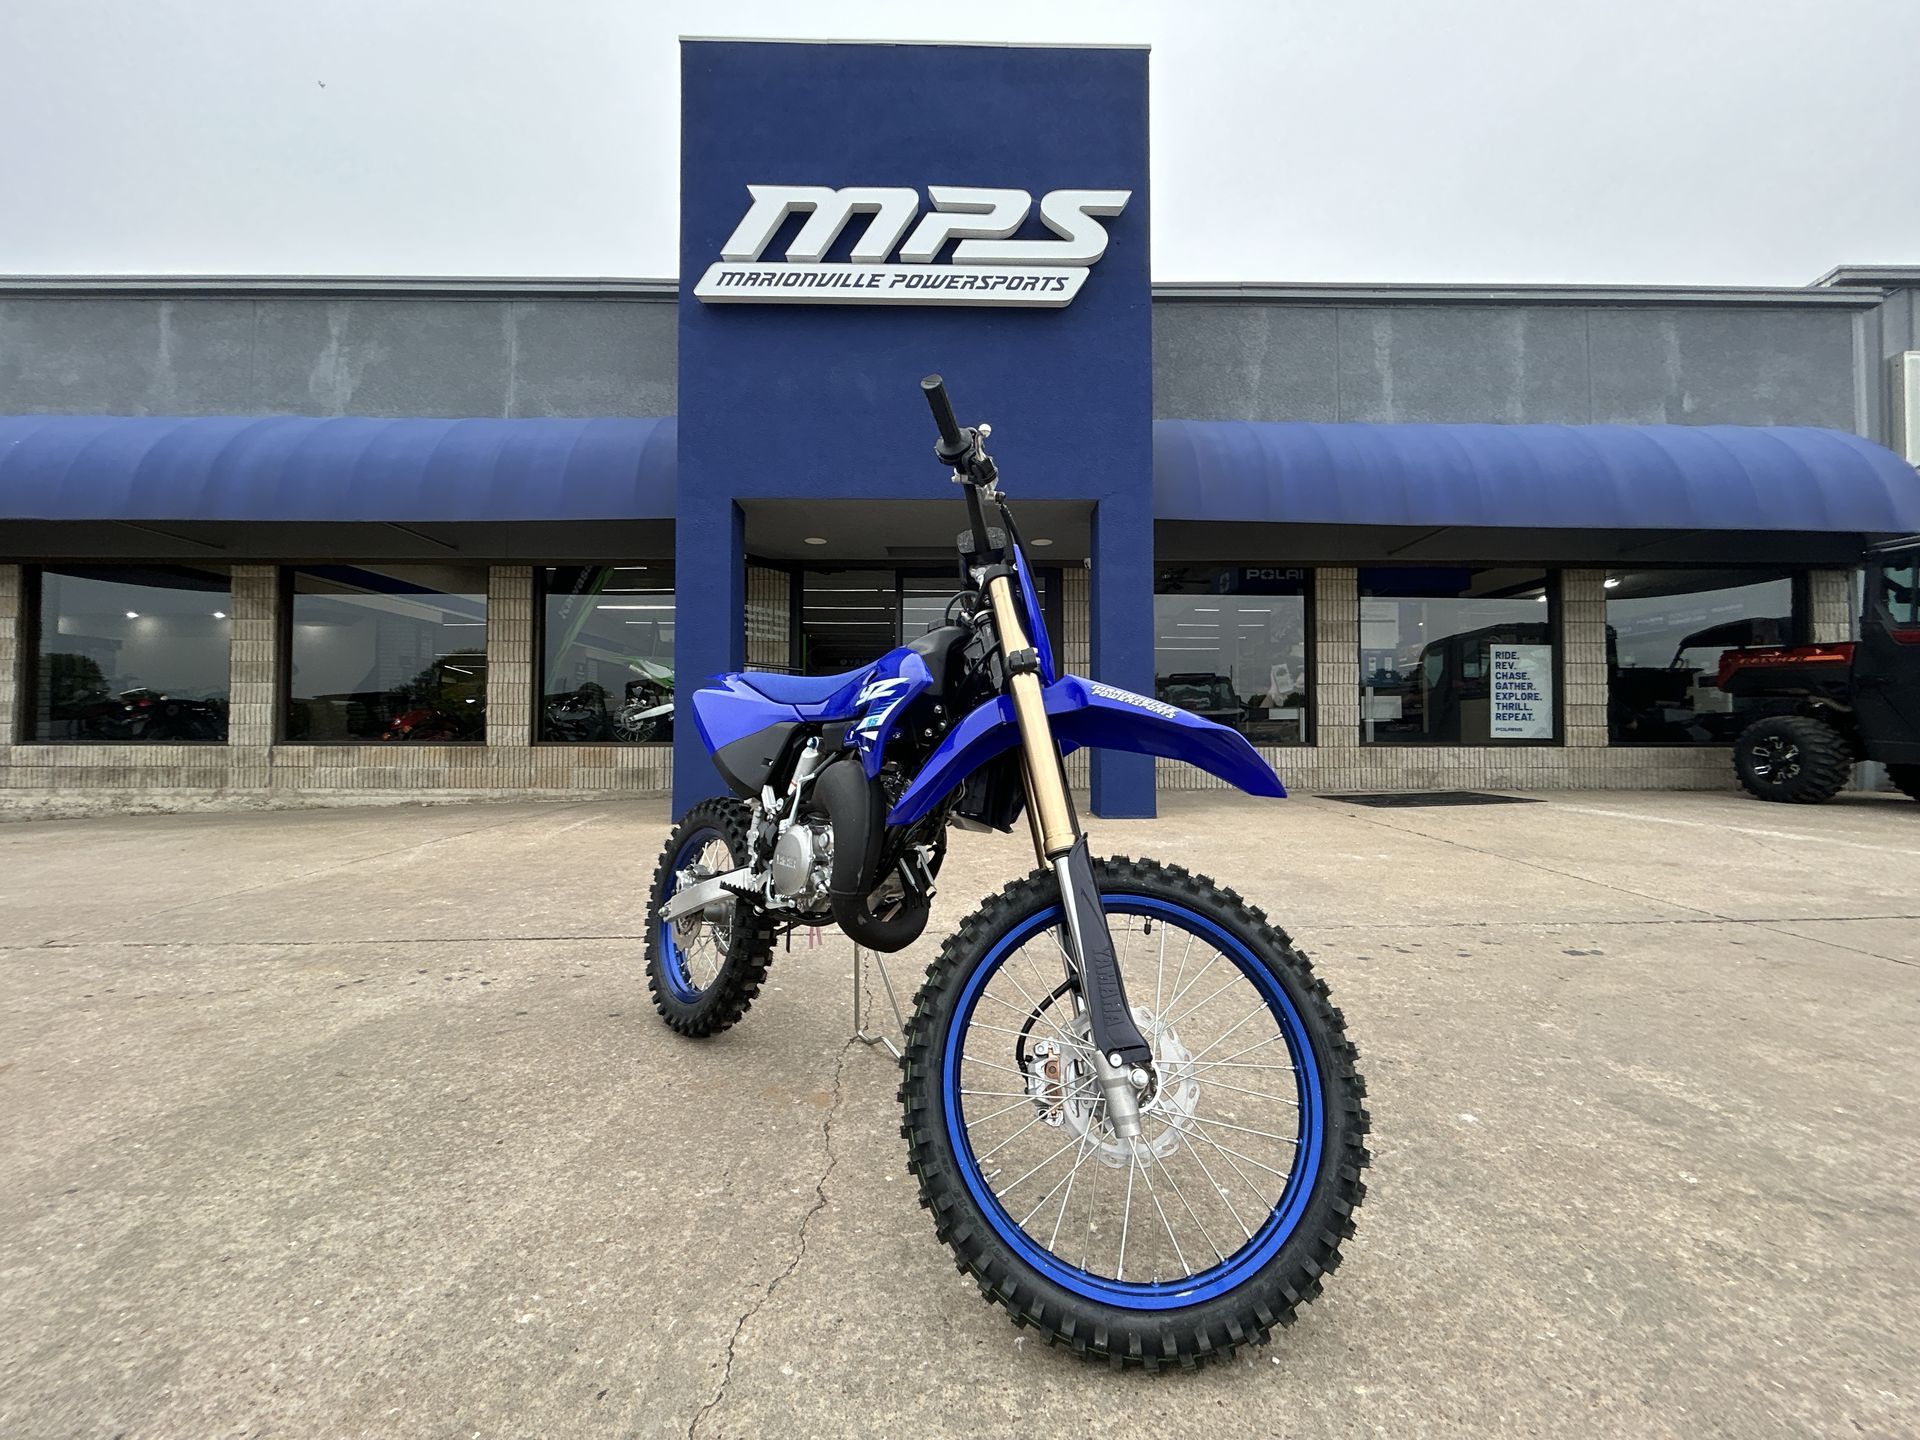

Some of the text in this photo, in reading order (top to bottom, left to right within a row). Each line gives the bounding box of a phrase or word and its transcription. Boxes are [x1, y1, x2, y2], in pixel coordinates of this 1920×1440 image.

[720, 184, 1133, 264] MPS
[715, 271, 1069, 292] MARIONVILLE POWERSPORTS
[1495, 651, 1520, 660] RIDE.
[1495, 661, 1517, 670] REV.
[1495, 671, 1530, 680] CHASE.
[1495, 682, 1536, 691] GATHER.
[1495, 692, 1543, 701] EXPLORE.
[1495, 702, 1533, 711] THRILL.
[1495, 712, 1535, 721] REPEAT.
